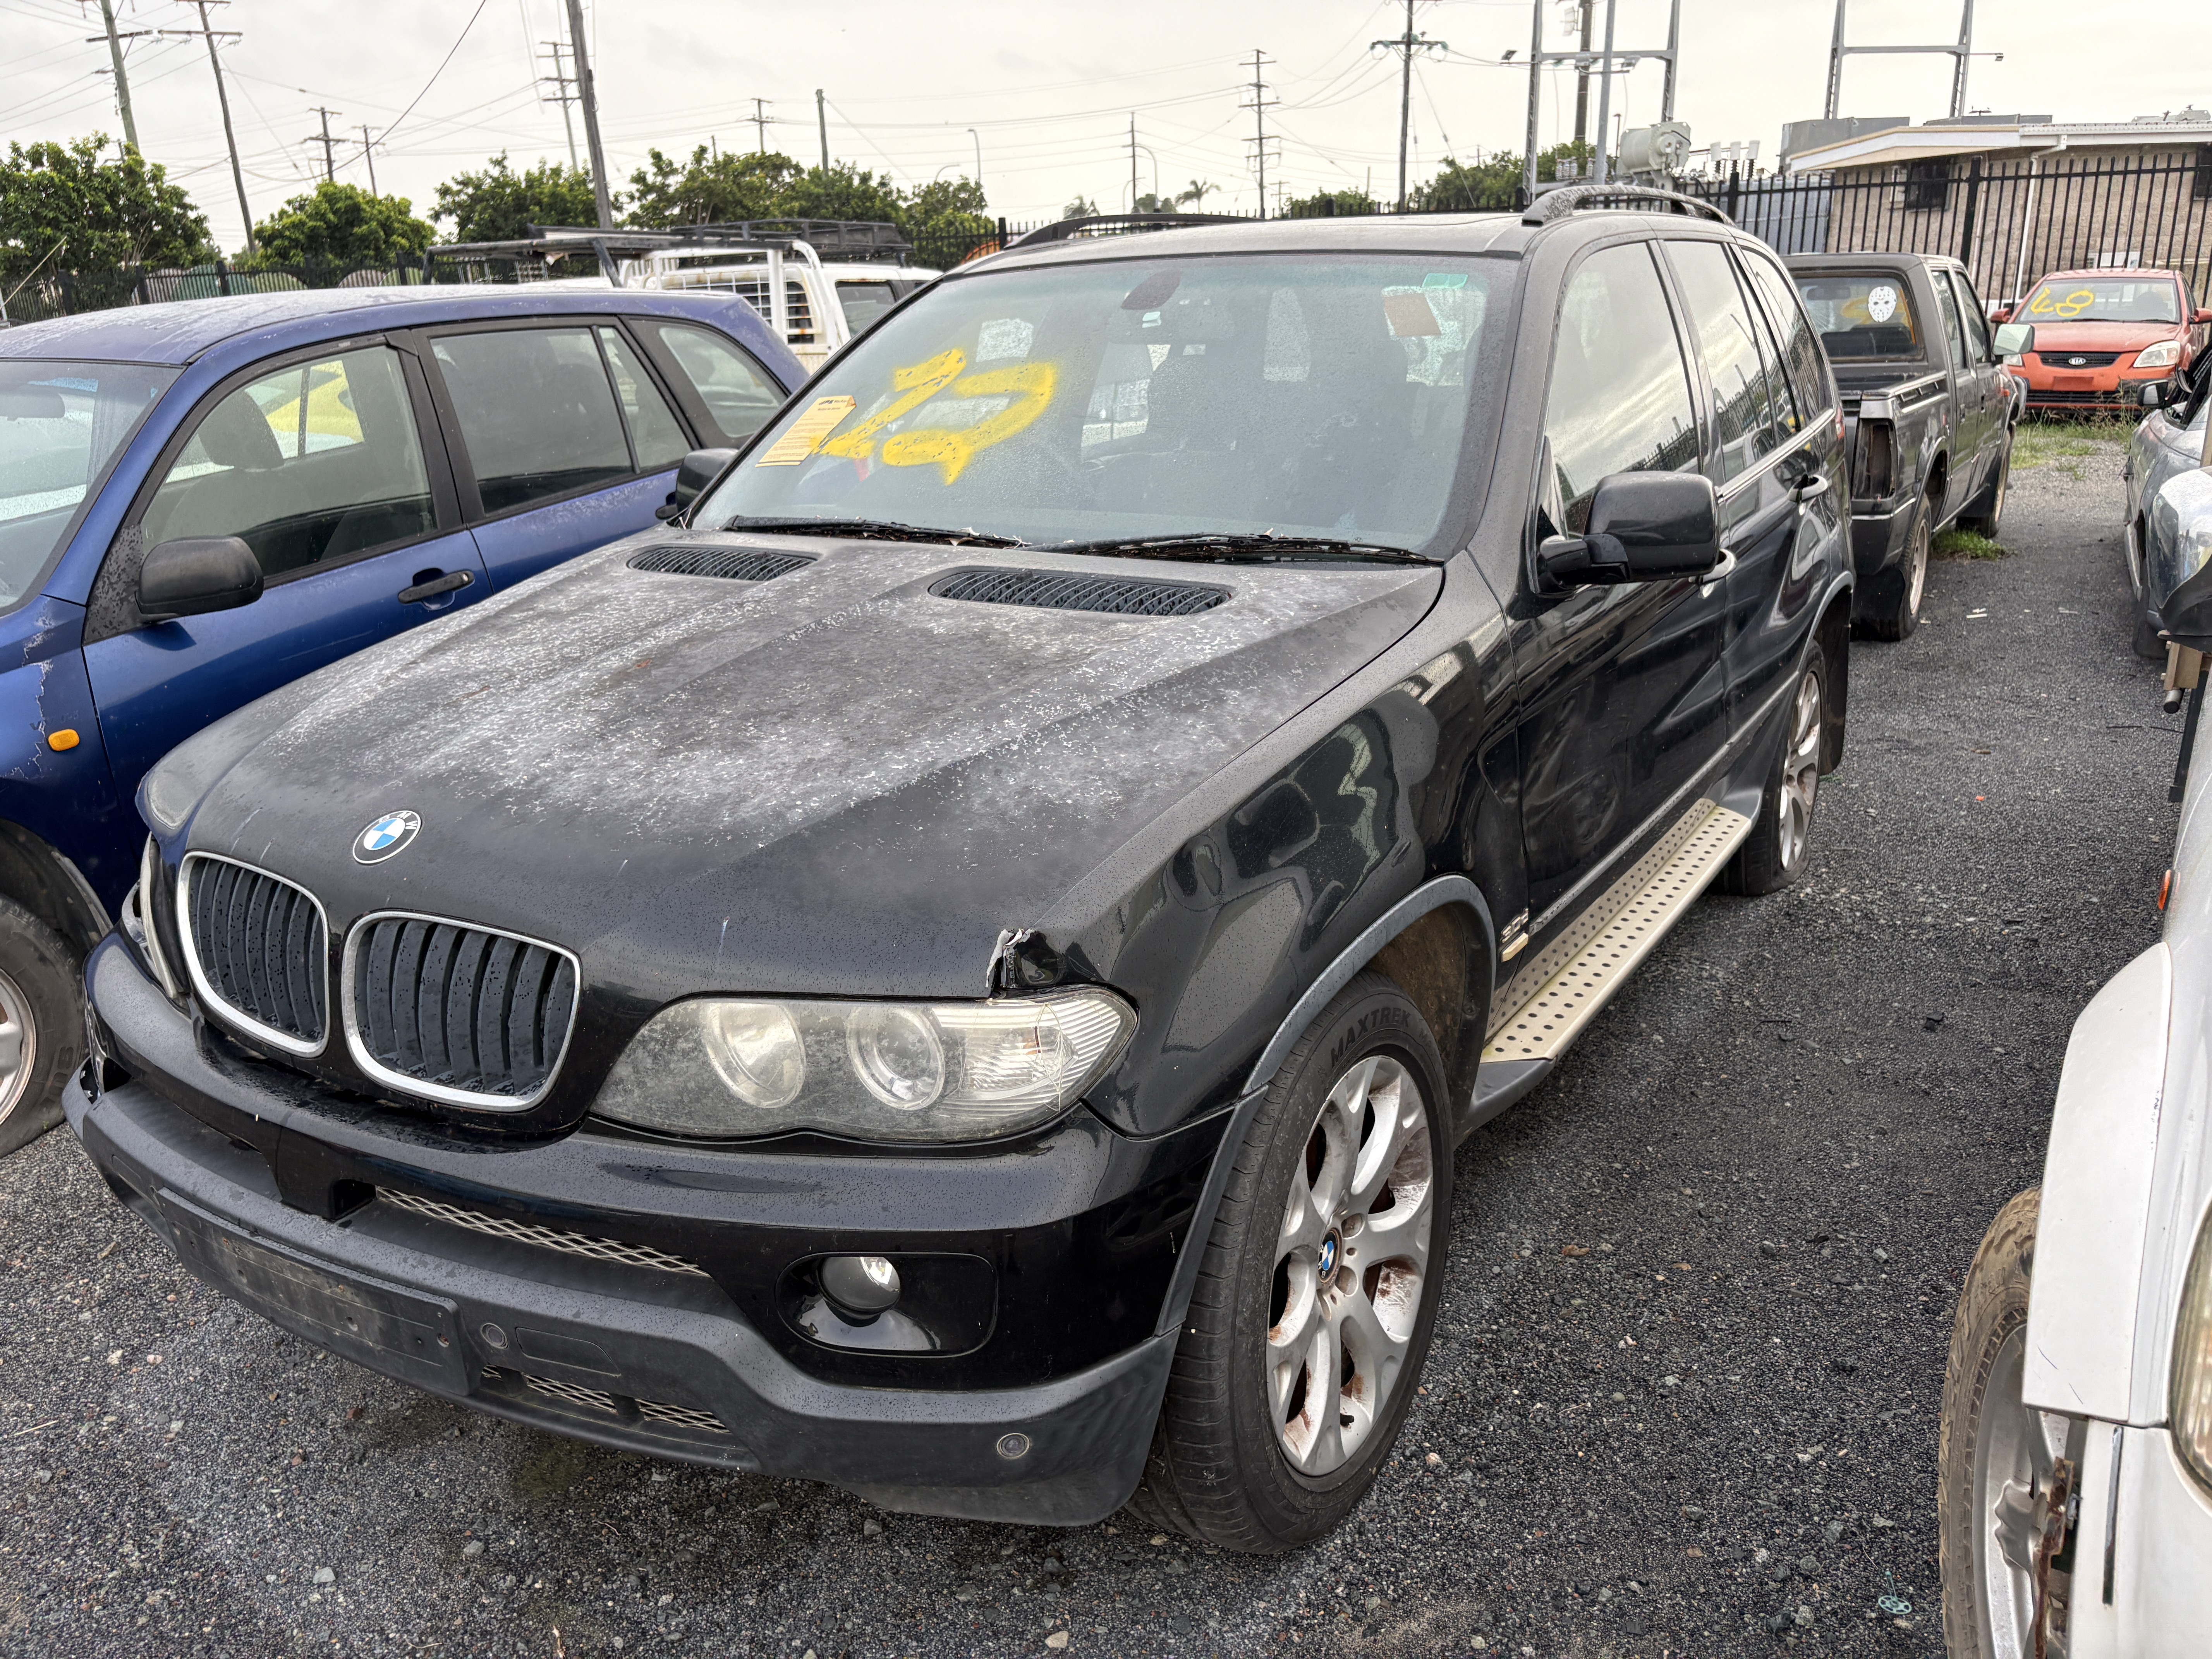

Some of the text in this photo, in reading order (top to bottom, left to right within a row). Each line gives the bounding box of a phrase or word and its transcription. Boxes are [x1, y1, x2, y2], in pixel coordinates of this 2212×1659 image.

[2031, 287, 2094, 318] 68
[379, 812, 418, 830] BMW
[1330, 1007, 1411, 1070] MAXTREK
